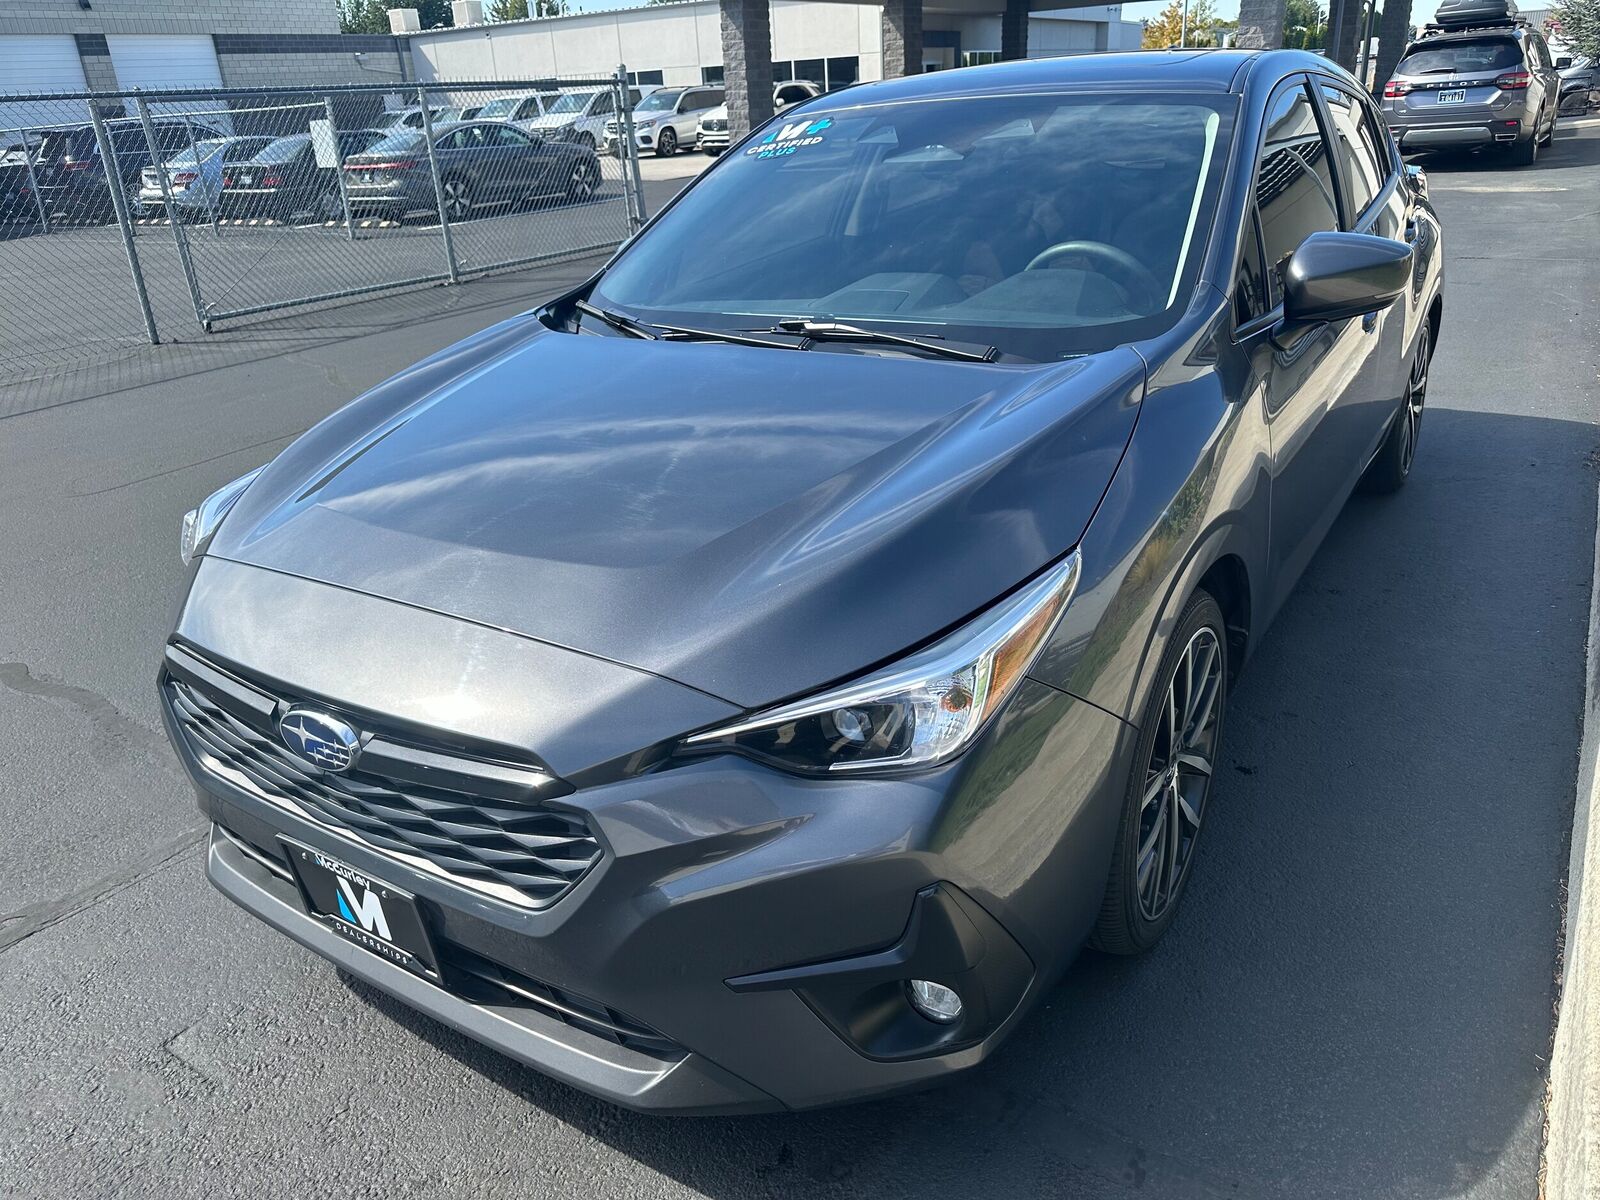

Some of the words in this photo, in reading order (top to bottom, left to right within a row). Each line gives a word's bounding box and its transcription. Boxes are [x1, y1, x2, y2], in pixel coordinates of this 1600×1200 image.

[1426, 80, 1479, 89] PILOT
[746, 136, 823, 155] CERTIFIED
[757, 146, 796, 159] PLUS
[315, 853, 370, 891] McCurley
[336, 922, 408, 964] DEALERSHIPS
